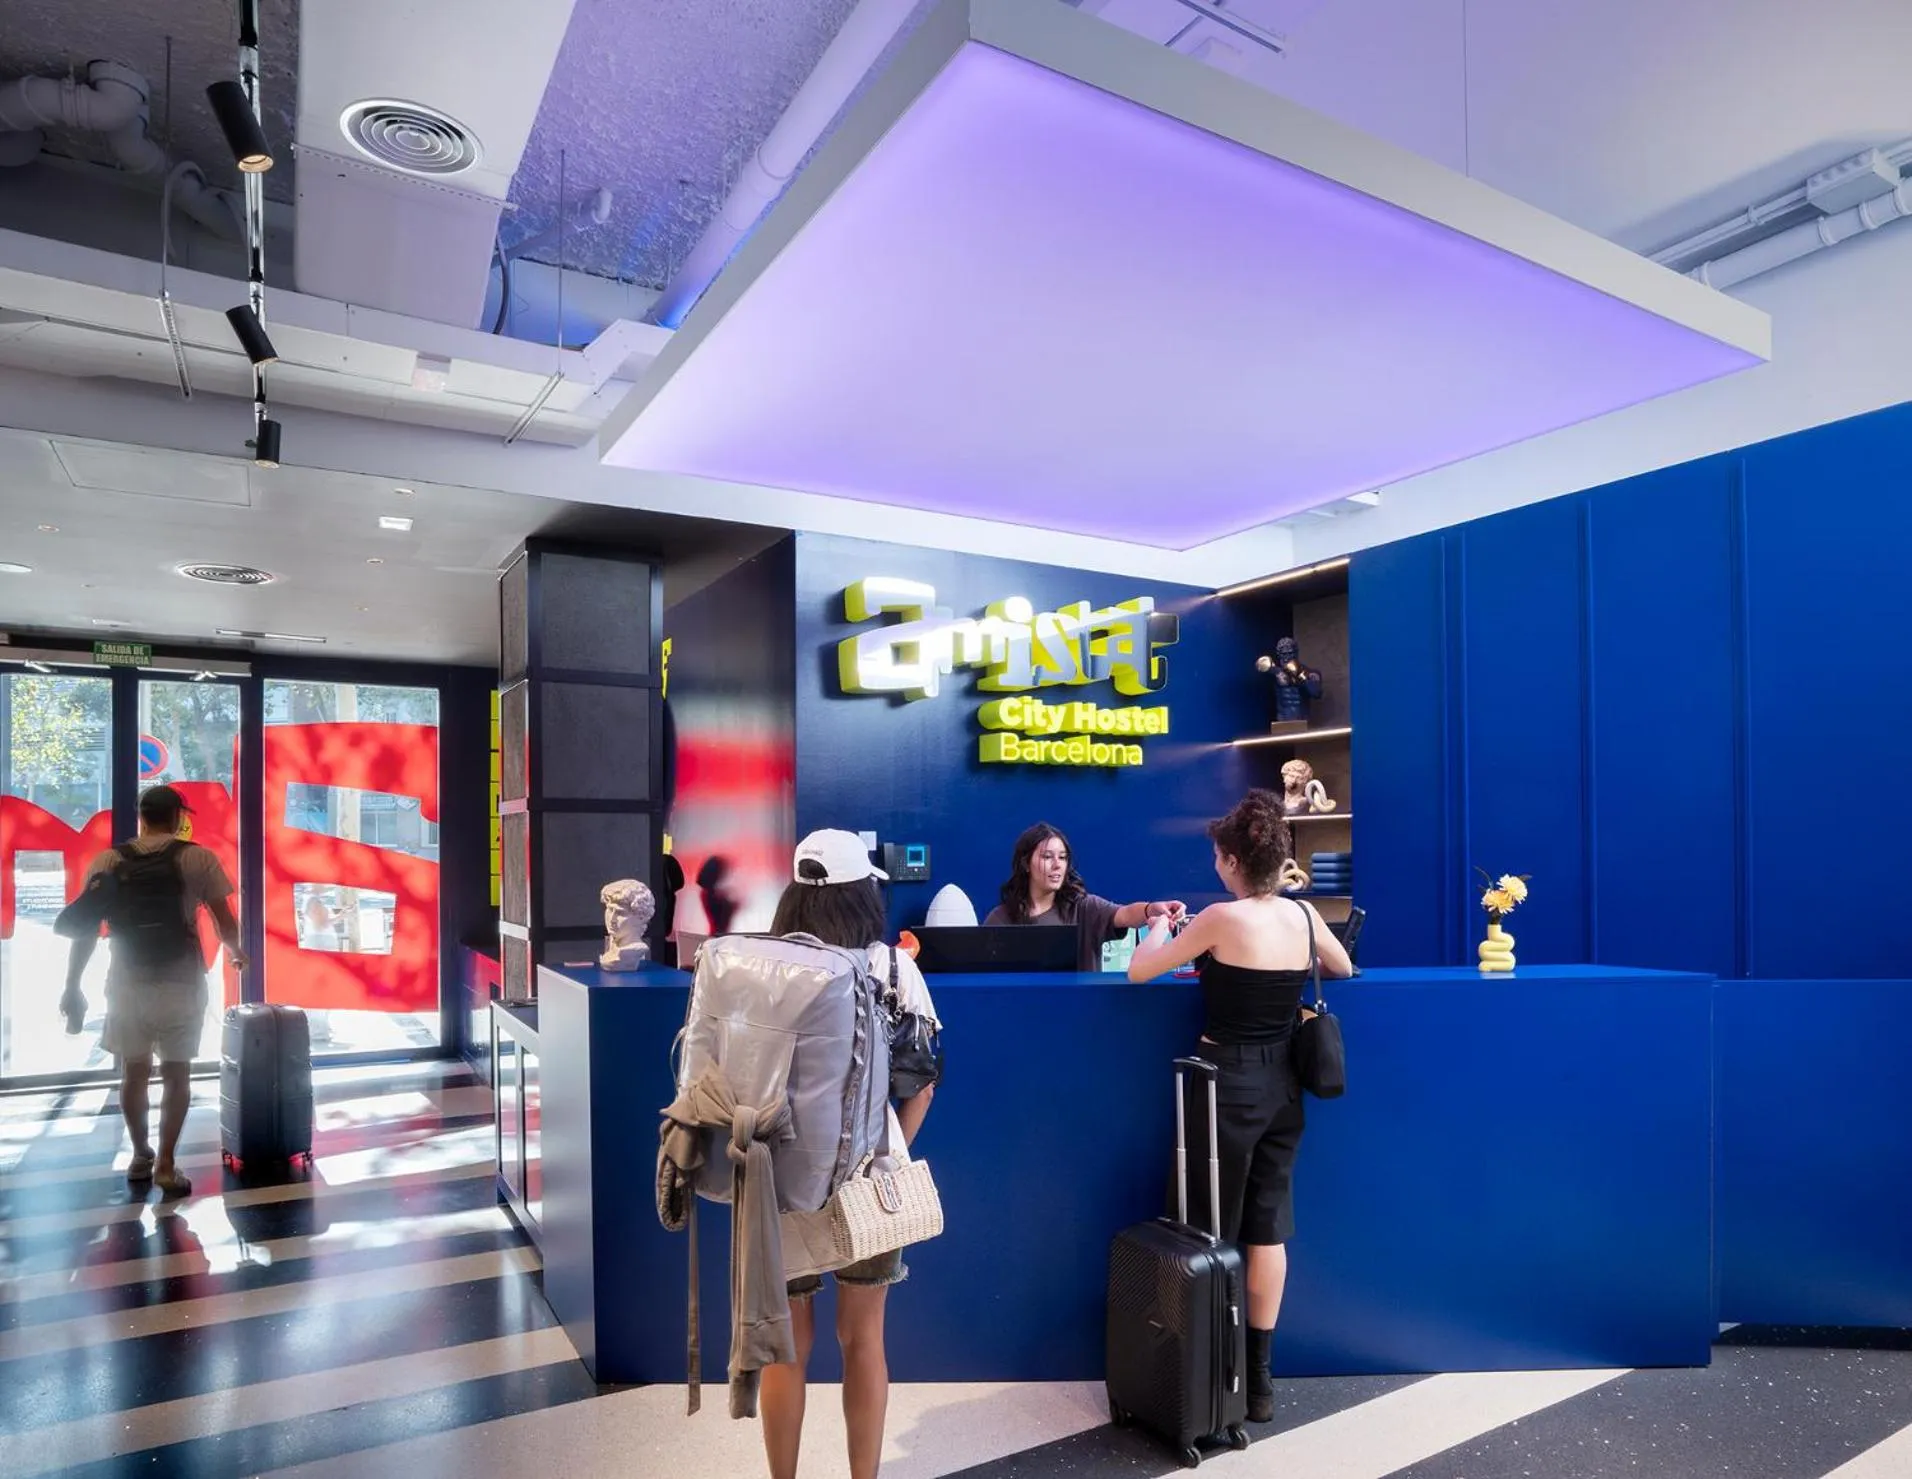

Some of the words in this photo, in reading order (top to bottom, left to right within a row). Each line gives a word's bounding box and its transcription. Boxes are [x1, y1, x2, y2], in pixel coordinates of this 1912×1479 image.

[95, 653, 149, 665] EMERGENCIA
[101, 644, 132, 654] SALIDA
[133, 645, 144, 655] DE
[997, 696, 1067, 735] City
[1072, 702, 1169, 735] Hostel
[997, 733, 1143, 766] Barcelona
